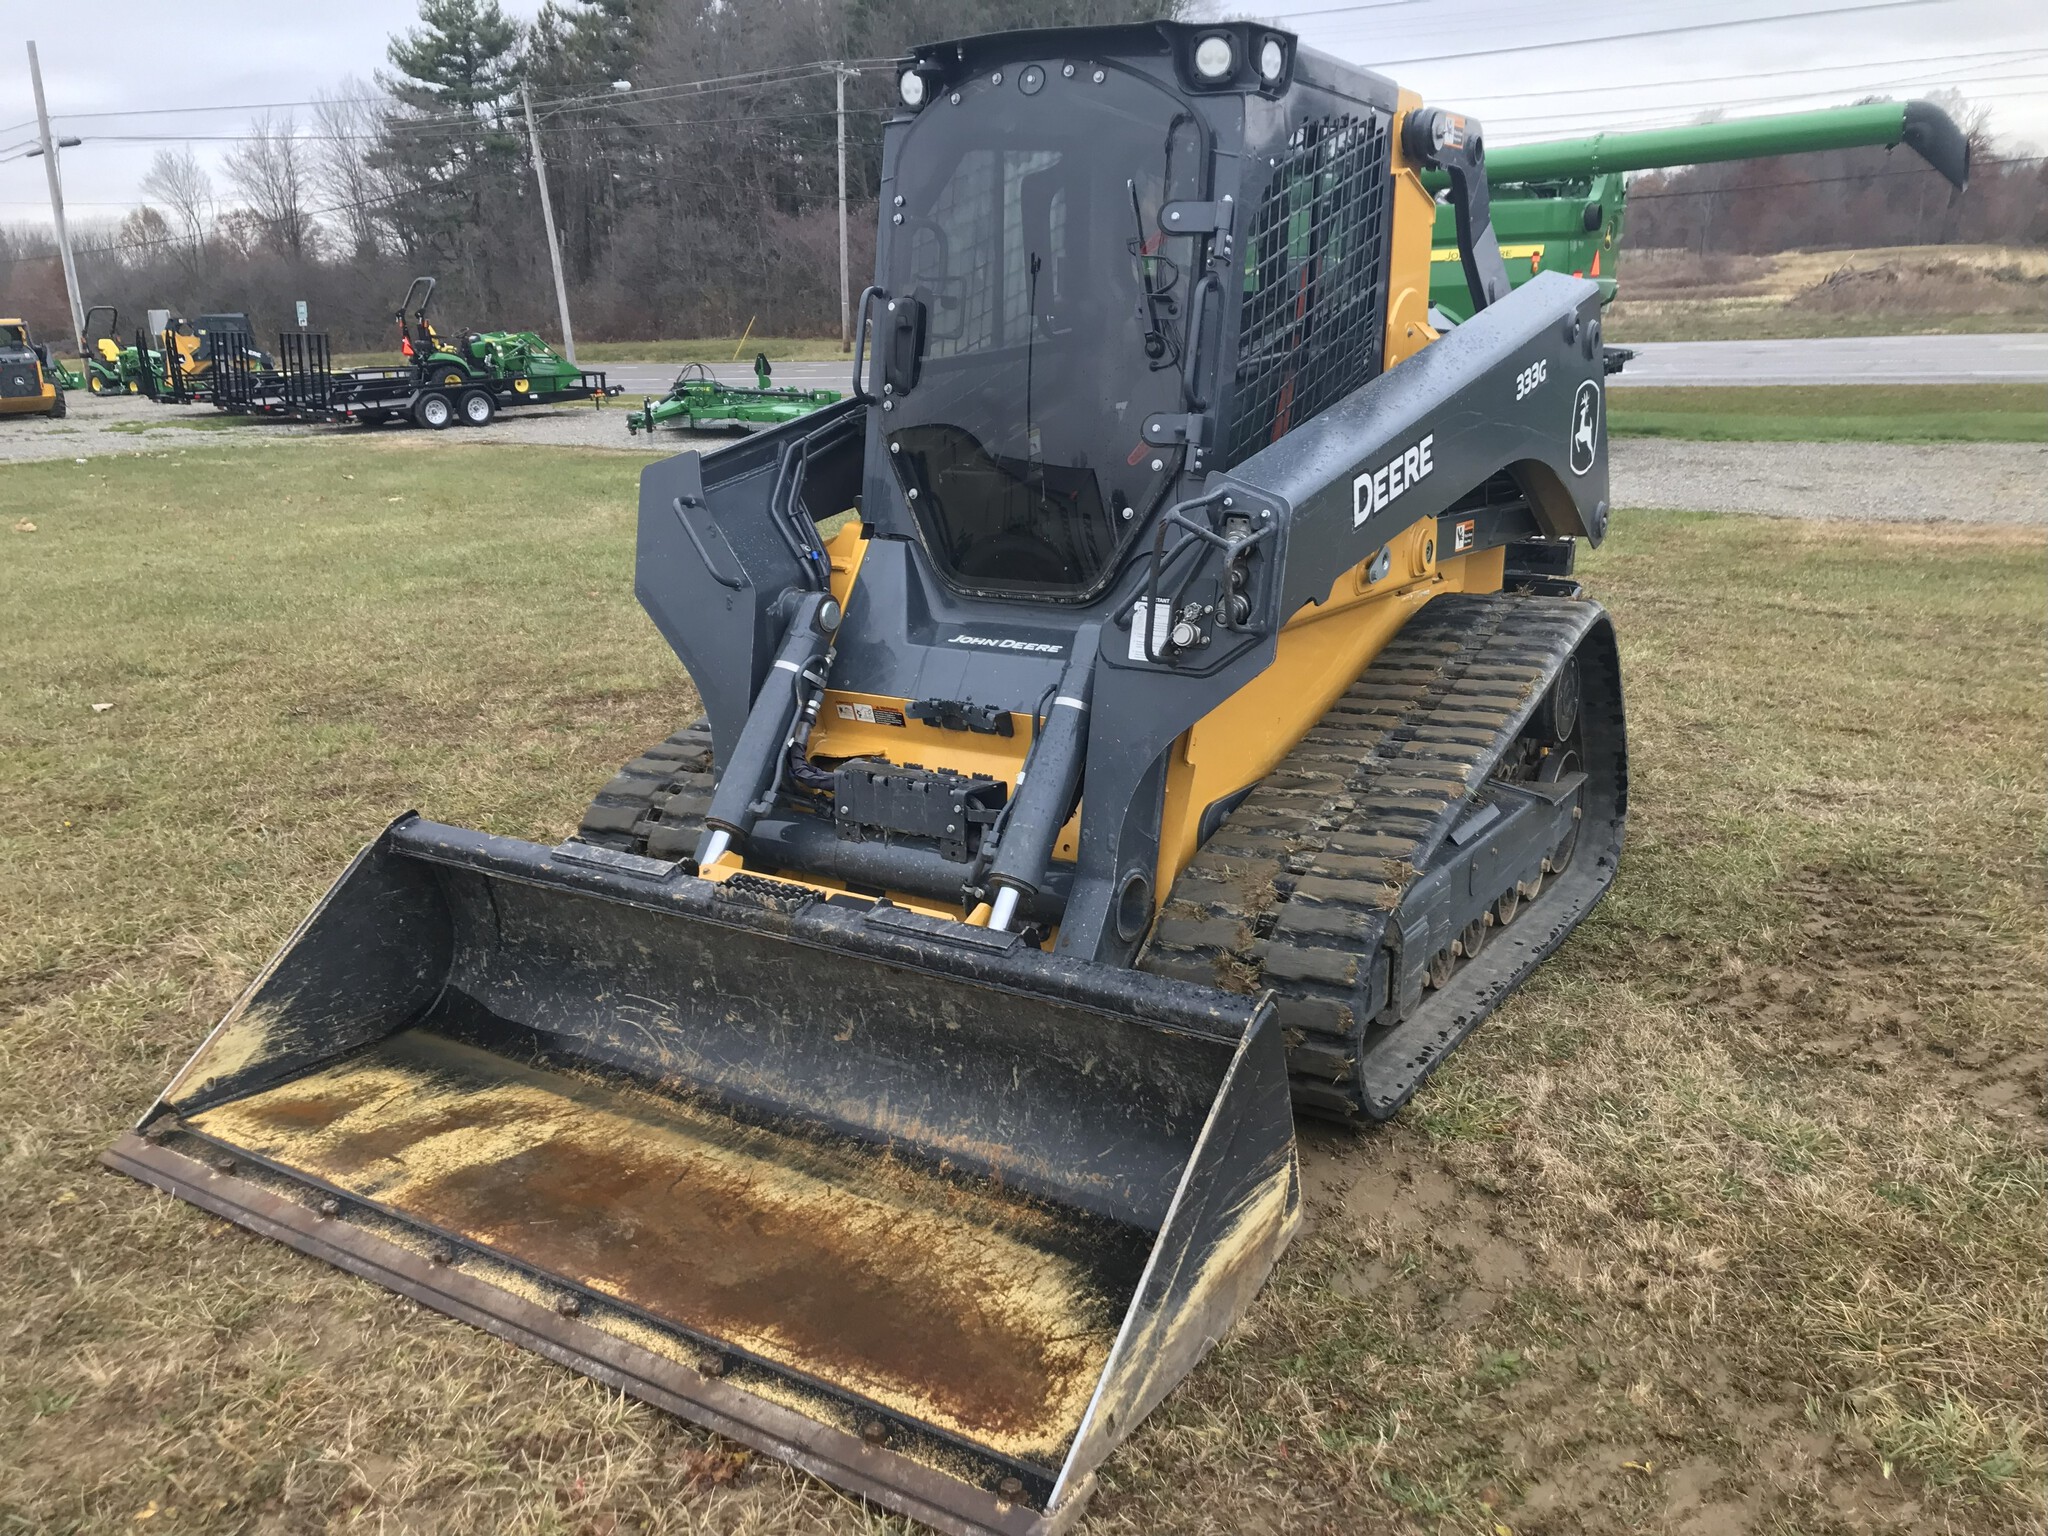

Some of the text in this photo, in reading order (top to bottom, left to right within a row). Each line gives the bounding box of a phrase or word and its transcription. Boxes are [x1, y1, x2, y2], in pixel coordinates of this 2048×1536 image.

[1516, 359, 1547, 401] 333G
[1353, 433, 1434, 528] DEERE
[948, 634, 1064, 653] JOHN DEERE
